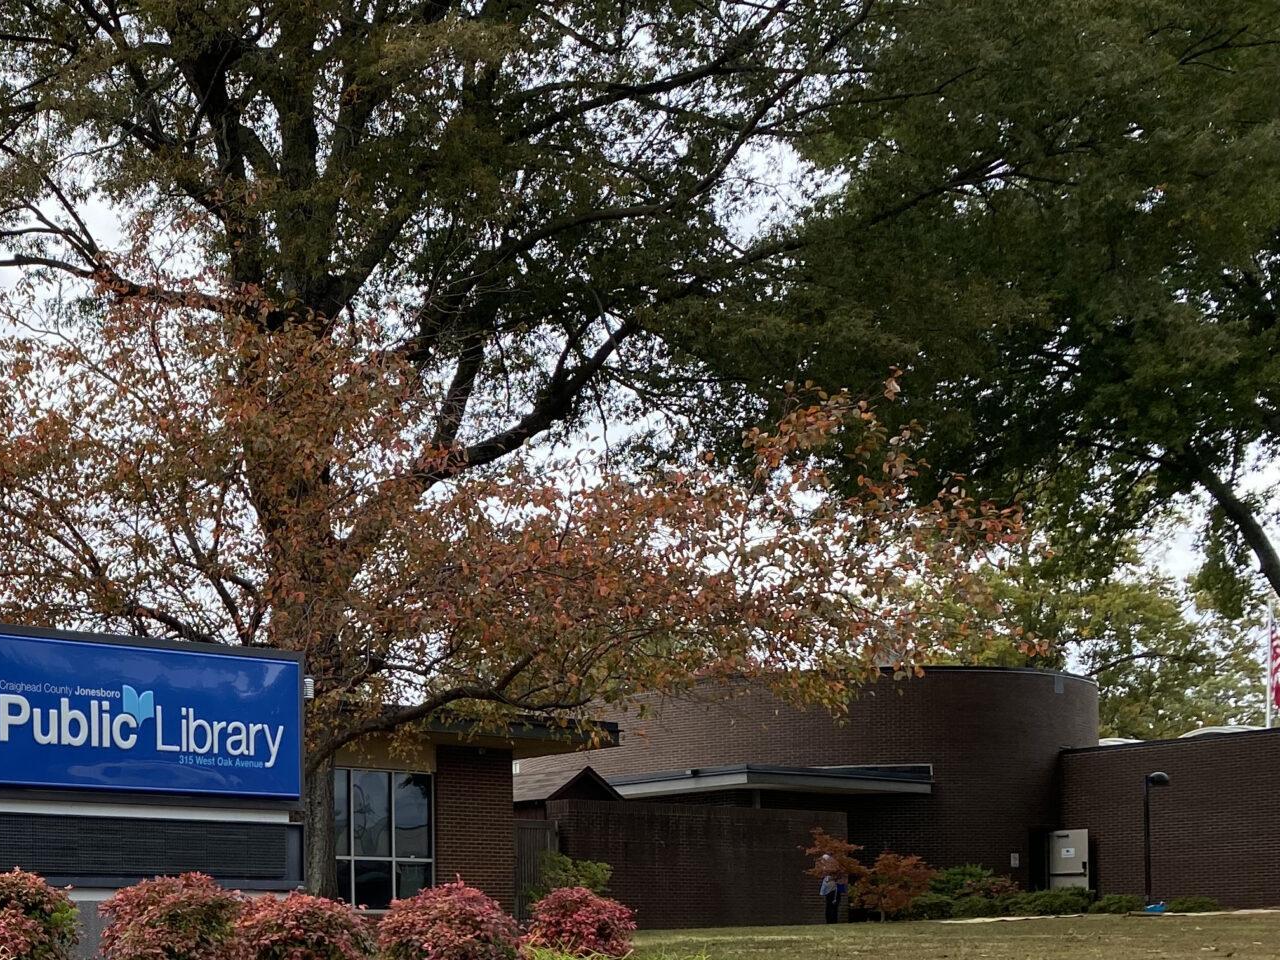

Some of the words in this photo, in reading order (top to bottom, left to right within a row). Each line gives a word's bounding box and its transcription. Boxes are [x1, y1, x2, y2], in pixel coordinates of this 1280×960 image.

[0, 680, 42, 694] Craighead
[44, 682, 72, 696] County
[74, 685, 120, 699] Jonesboro
[156, 705, 284, 768] Library
[178, 756, 194, 765] 315
[196, 756, 214, 766] West
[217, 757, 232, 767] Oak
[234, 758, 264, 768] Avenue
